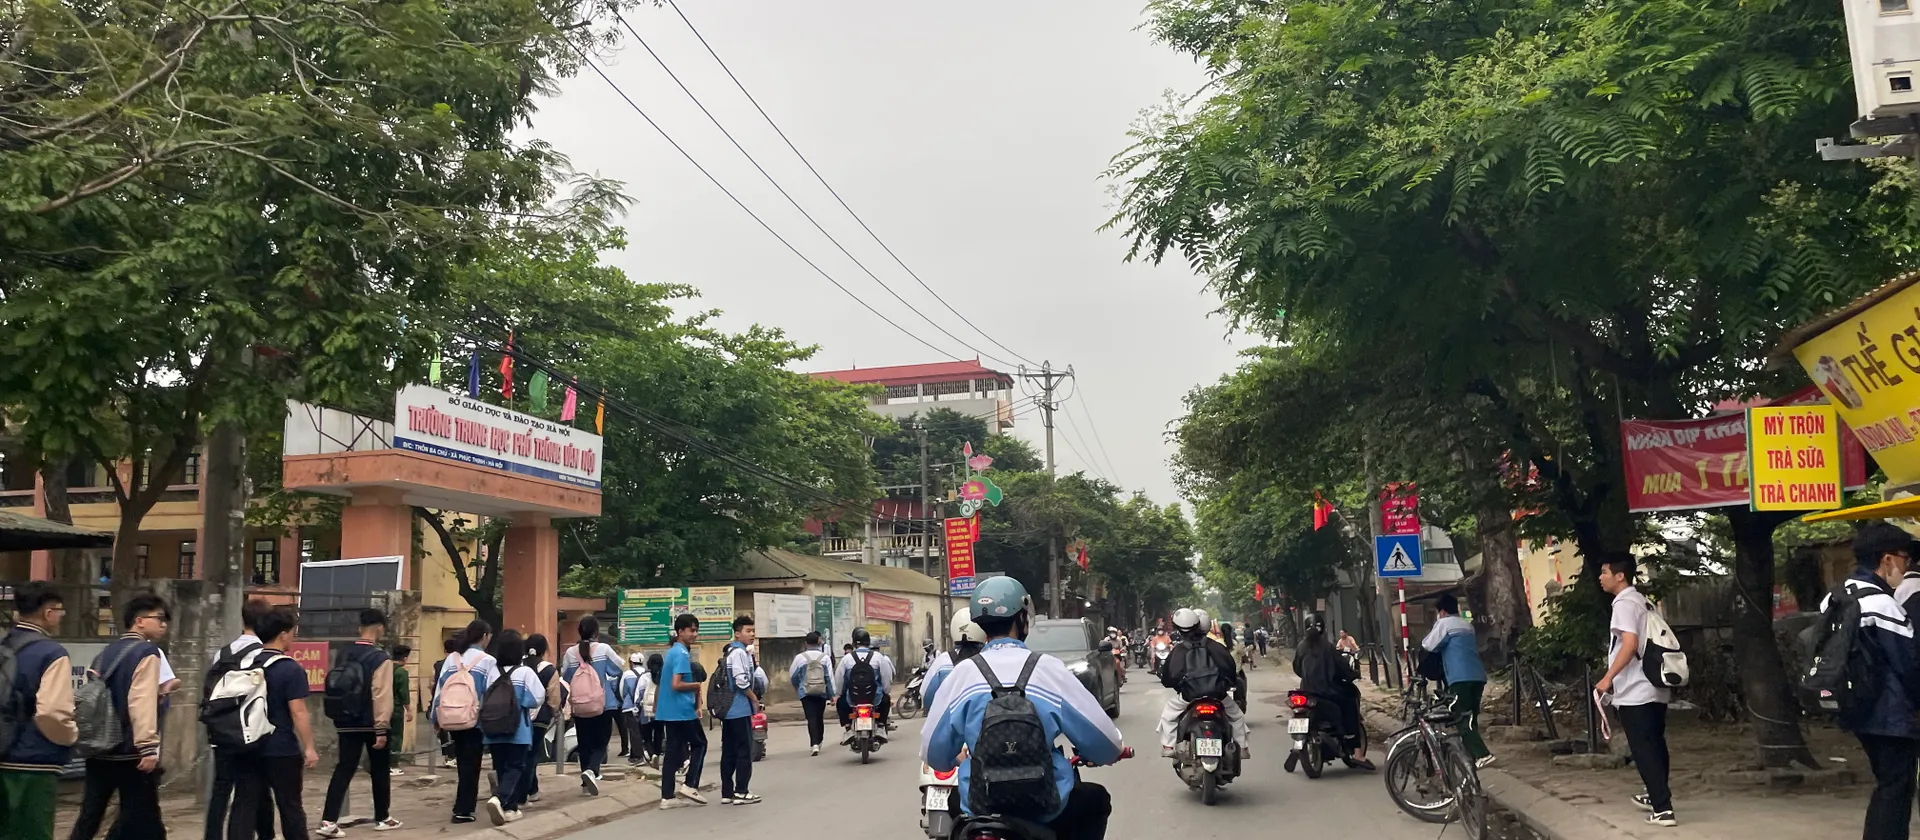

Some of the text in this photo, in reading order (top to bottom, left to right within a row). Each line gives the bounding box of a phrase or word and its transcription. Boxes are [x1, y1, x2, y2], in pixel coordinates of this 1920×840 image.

[1840, 321, 1904, 393] THẾ
[448, 395, 571, 437] SỞ GIÁO DỤC VÀ ĐÀO TẠO HÀ NỘI
[1788, 411, 1825, 439] TRỘN
[408, 404, 596, 476] TRƯỜNG TRUNG HỌC PHỔ THÔNG VÂN NỘI
[1627, 418, 1746, 451] NHÂN DỊP KHA
[415, 443, 429, 453] THÔN
[459, 453, 472, 462] PHÚC
[1767, 447, 1825, 470] TRÀ SỮA
[1642, 472, 1682, 495] MUA
[1759, 480, 1837, 504] TRÀ CHANH
[928, 798, 947, 808] 459.
